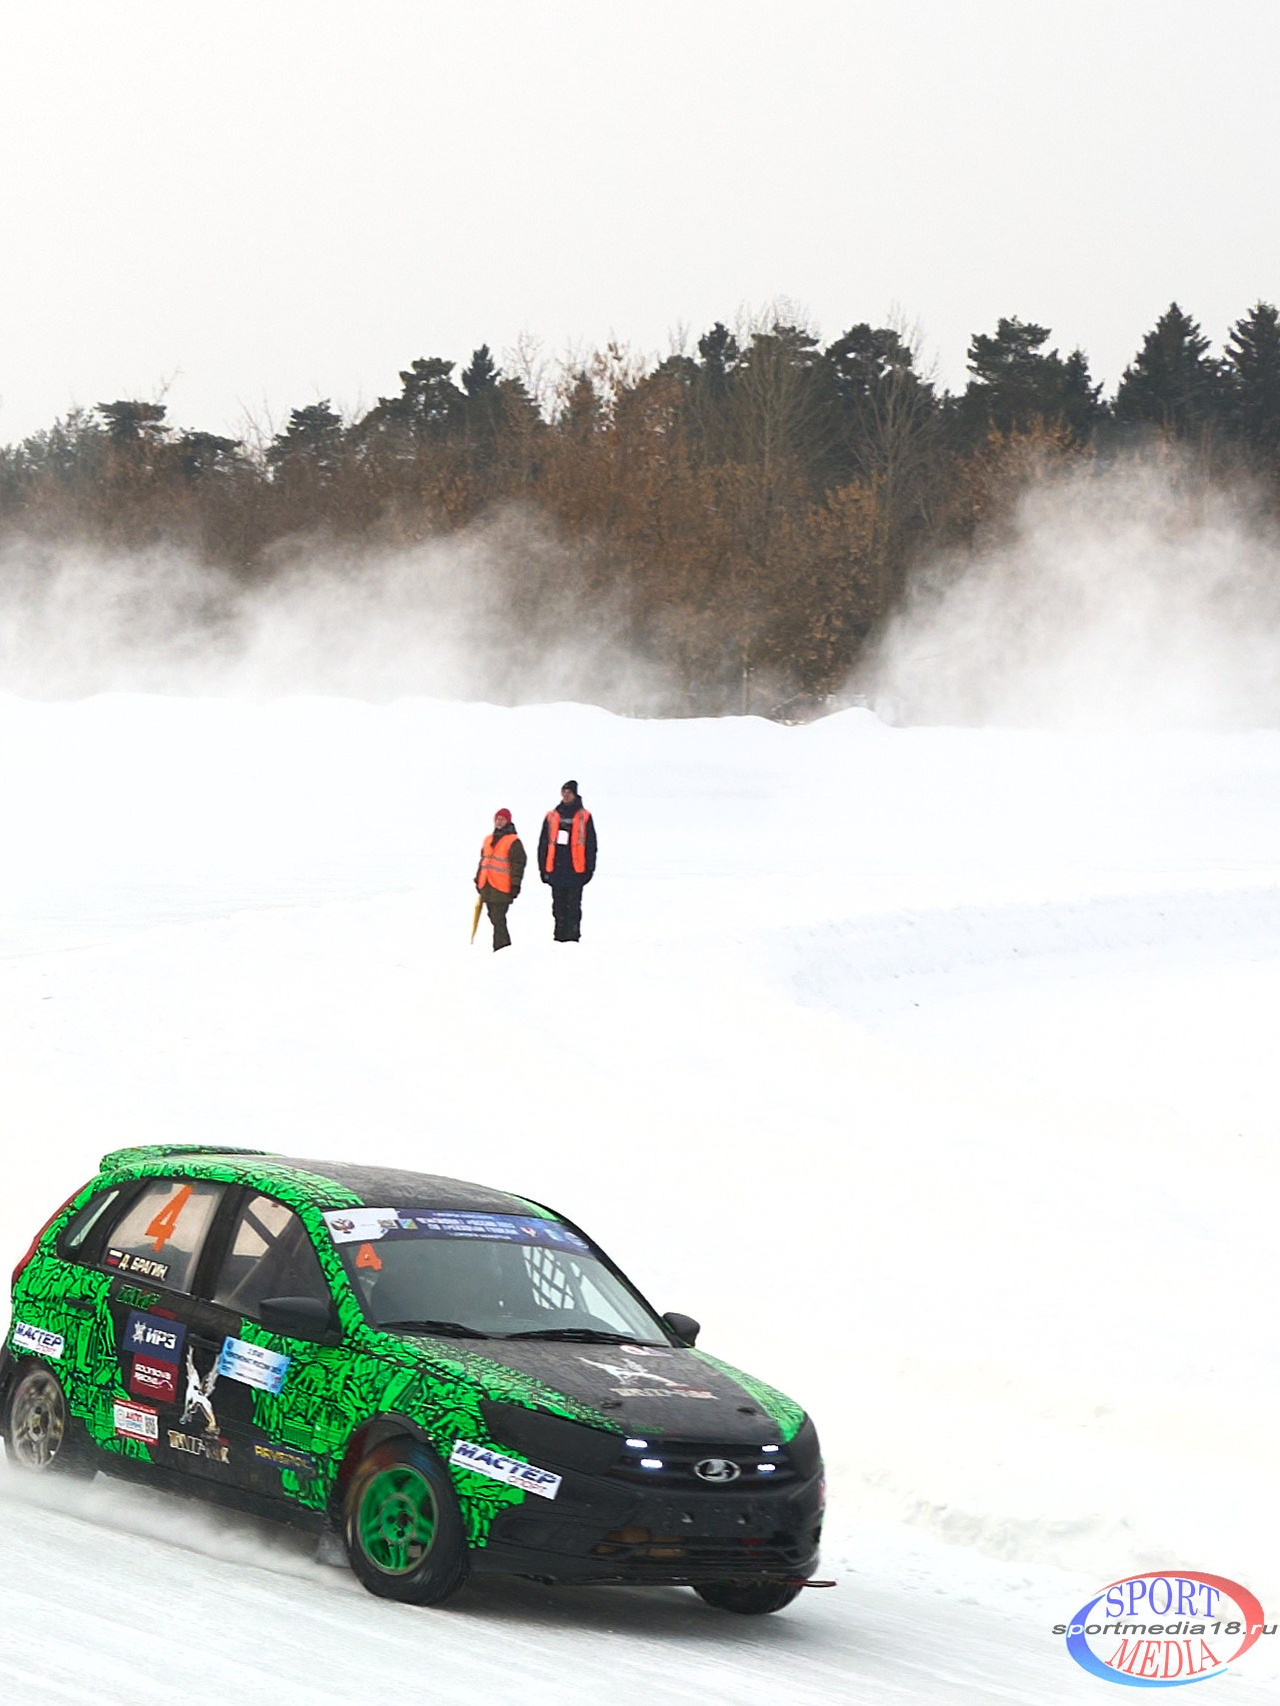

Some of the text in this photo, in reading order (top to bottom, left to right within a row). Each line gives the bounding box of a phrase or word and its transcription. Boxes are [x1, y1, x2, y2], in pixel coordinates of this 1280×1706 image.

[144, 1183, 195, 1253] 4
[355, 1243, 382, 1271] 4
[16, 1323, 62, 1346] МАСТЕР
[455, 1443, 557, 1484] МАСТЕР
